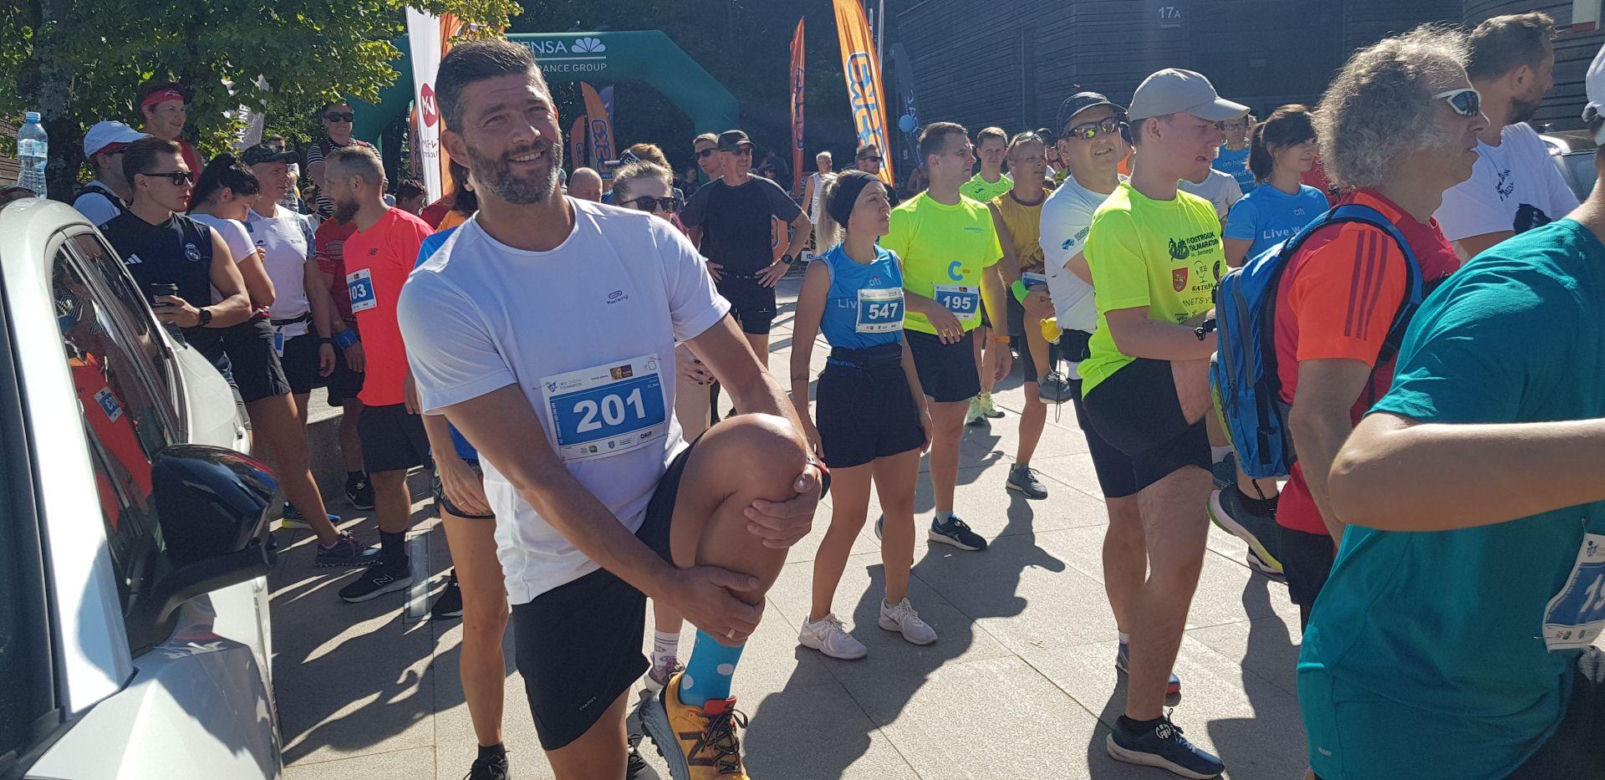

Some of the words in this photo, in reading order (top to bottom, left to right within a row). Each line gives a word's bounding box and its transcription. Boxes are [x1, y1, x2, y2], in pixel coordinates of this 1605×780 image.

[572, 63, 607, 72] GROUP
[1263, 227, 1290, 240] Live
[837, 298, 856, 309] Liv
[943, 295, 971, 310] 195
[868, 302, 898, 320] 547
[573, 387, 647, 434] 201
